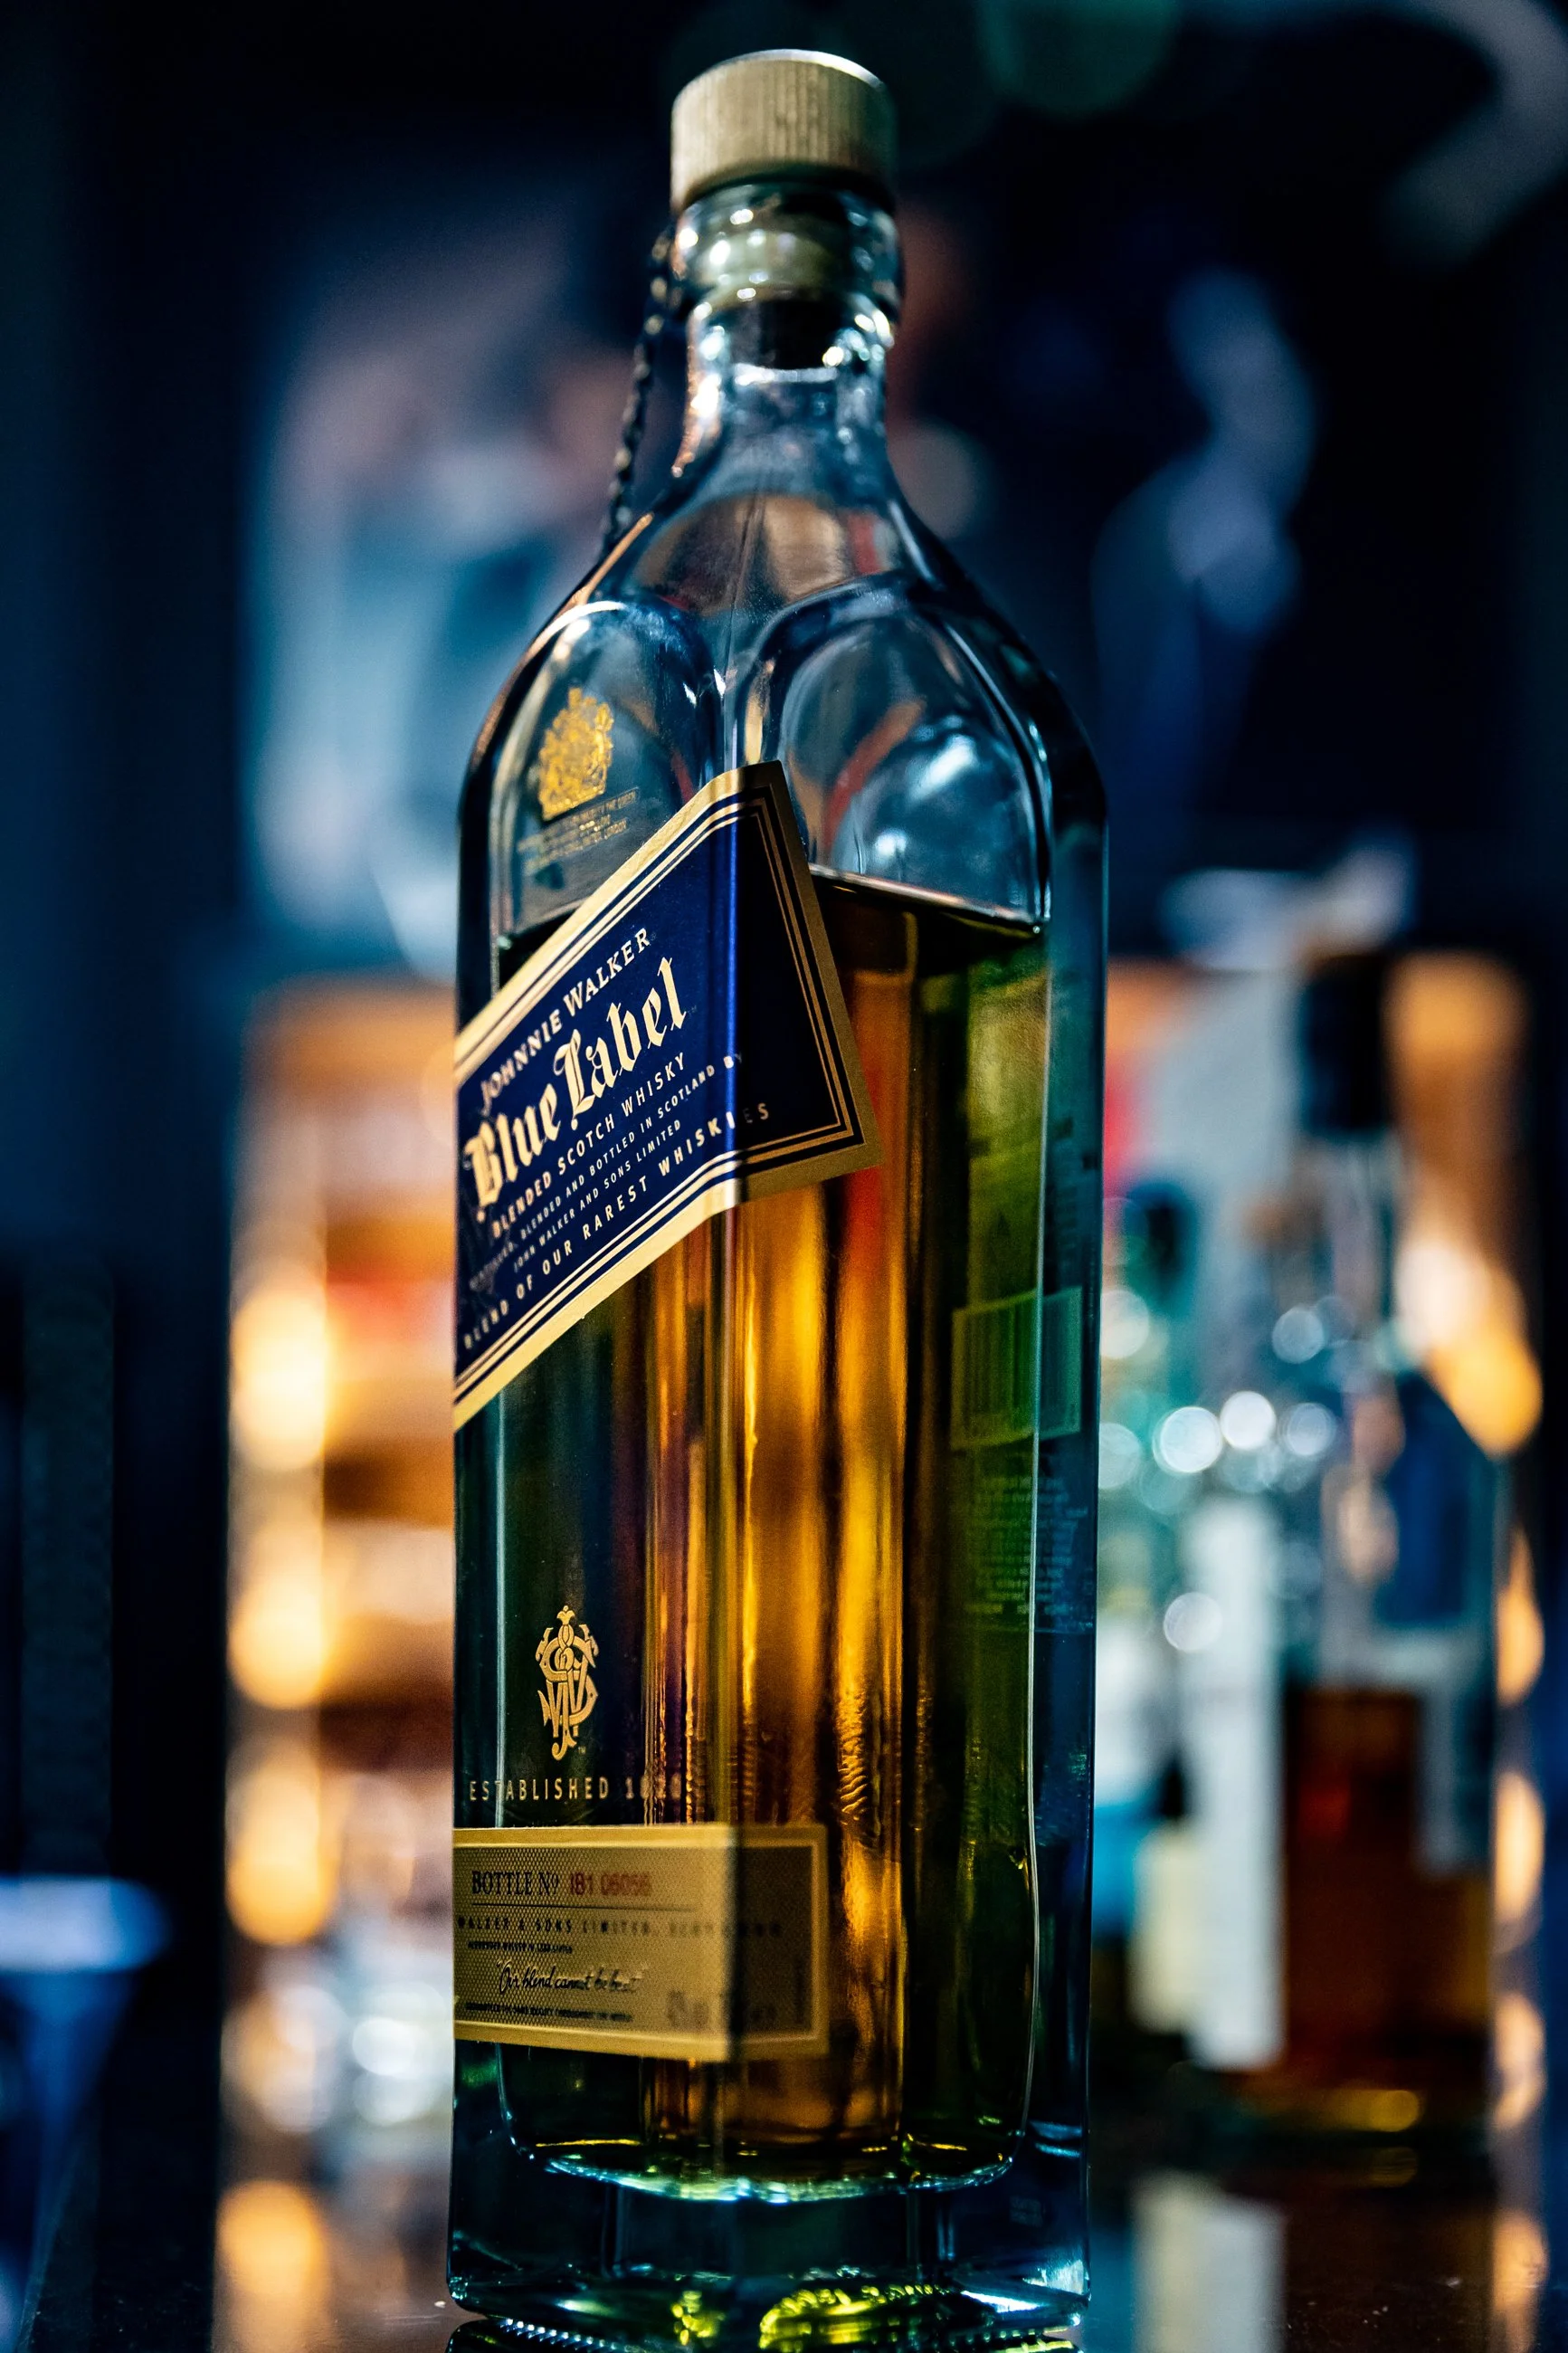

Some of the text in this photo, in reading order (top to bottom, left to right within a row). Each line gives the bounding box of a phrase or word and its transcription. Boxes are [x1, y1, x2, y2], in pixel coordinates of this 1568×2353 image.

[462, 1083, 561, 1222] Blue
[553, 957, 687, 1130] Label
[480, 1008, 563, 1117] JOHNNIE
[563, 928, 651, 1016] WALKER
[492, 1052, 684, 1238] BLENDED SCOTCH WHISKY
[514, 1244, 536, 1273] JOHN
[539, 1208, 575, 1246] WALKER
[579, 1187, 599, 1211] AND
[603, 1160, 632, 1189] SONS
[636, 1119, 680, 1162] LIMITED
[516, 1273, 533, 1300] OF
[542, 1239, 573, 1275] OUR
[582, 1176, 647, 1241] RAREST
[658, 1101, 769, 1176] WHISKIES
[520, 1196, 561, 1240] BLENDED
[565, 1175, 584, 1198] AND
[589, 1131, 635, 1176] BOTTLED
[640, 1116, 652, 1133] IN
[657, 1064, 715, 1119] SCOTLAND
[469, 1775, 610, 1802] ESTABLISHED
[470, 1870, 533, 1896] BOTTLE
[536, 1918, 572, 1934] SONS
[522, 1966, 556, 1990] blend
